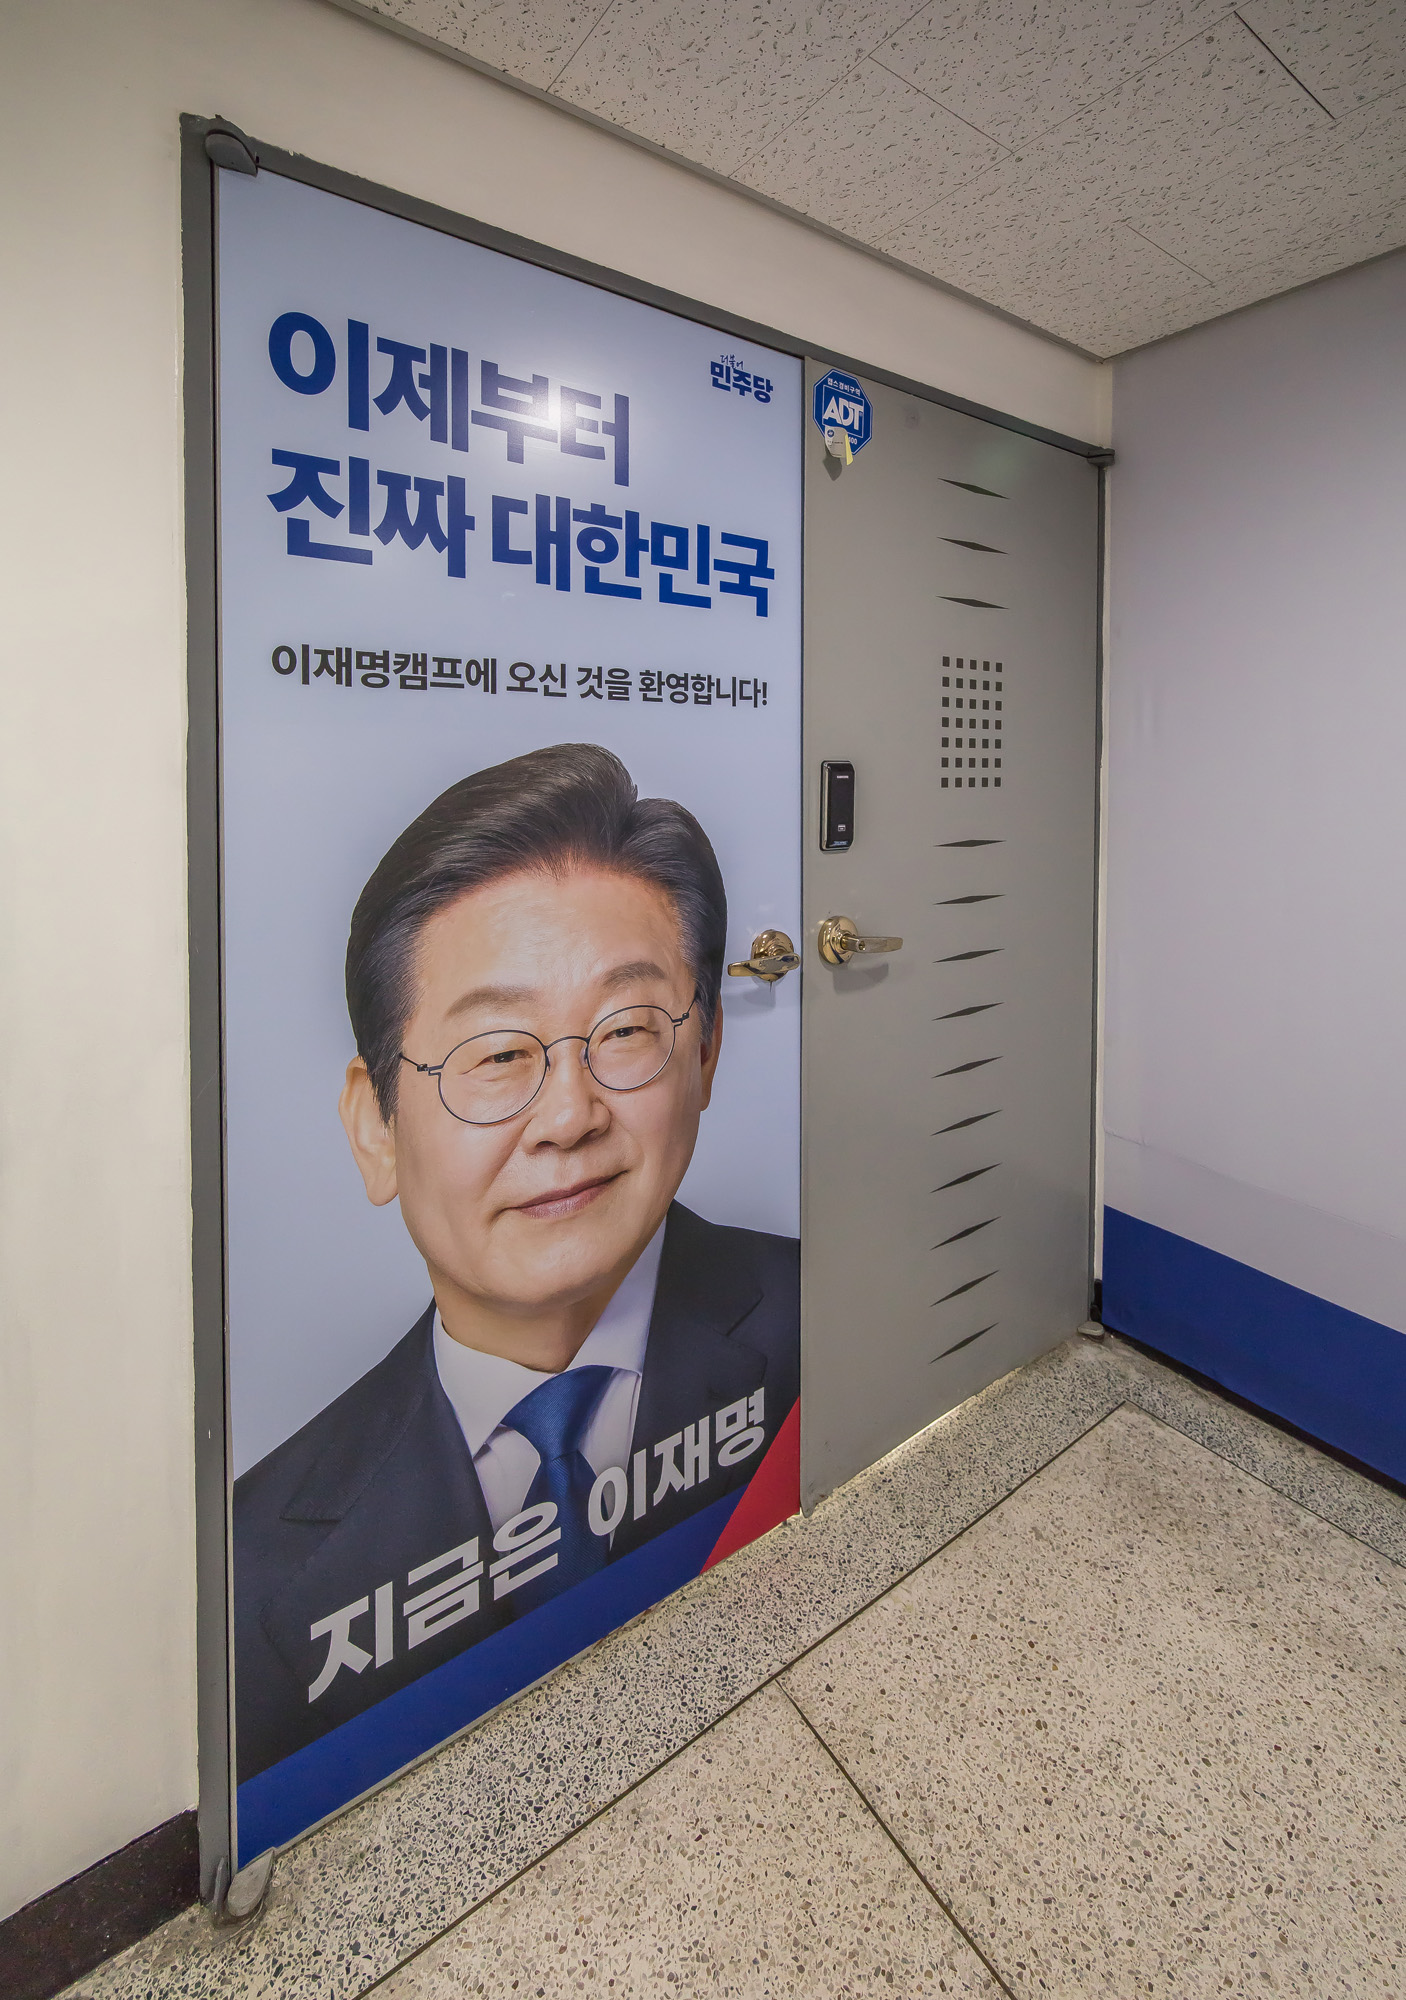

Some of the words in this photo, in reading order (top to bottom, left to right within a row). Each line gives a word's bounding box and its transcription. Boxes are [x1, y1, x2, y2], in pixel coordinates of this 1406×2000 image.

[710, 360, 774, 404] 민주당
[719, 354, 744, 370] 더불어
[267, 311, 630, 487] 이제부터
[822, 395, 864, 431] ADT
[266, 447, 475, 579] 진짜
[491, 493, 776, 618] 대한민국
[271, 643, 497, 695] 이재명캠프에
[506, 661, 568, 698] 오신
[576, 665, 633, 702] 것을
[638, 669, 768, 709] 환영합니다!
[308, 1501, 562, 1704] 지금은
[587, 1386, 765, 1537] 이재명
